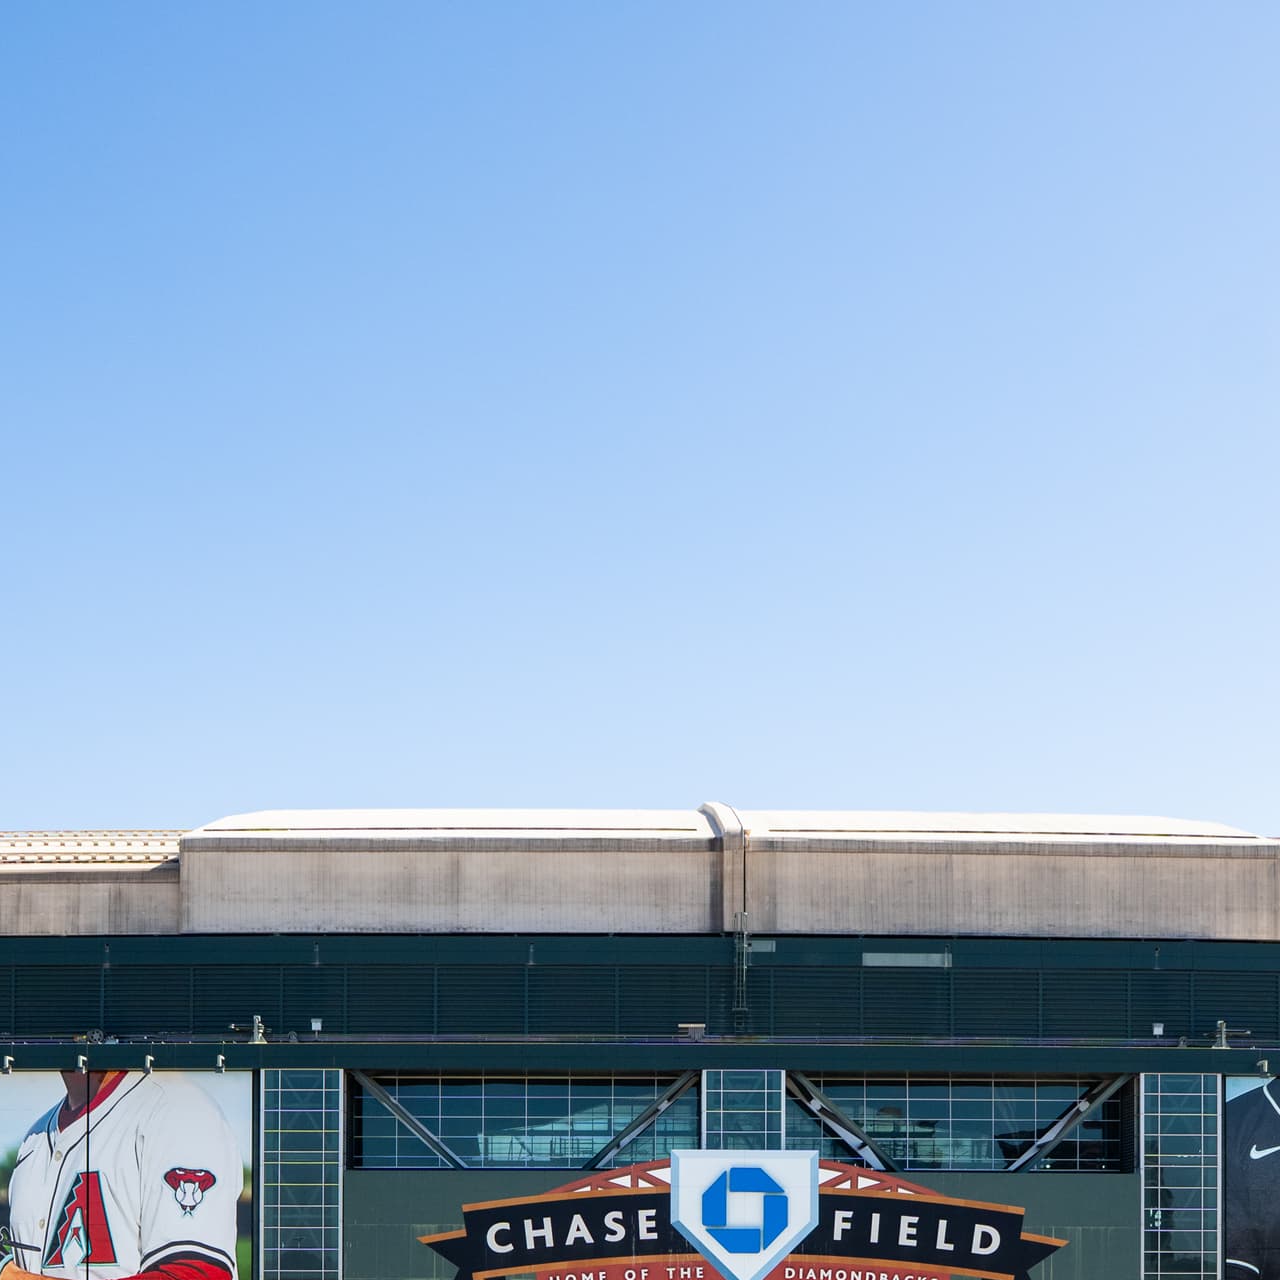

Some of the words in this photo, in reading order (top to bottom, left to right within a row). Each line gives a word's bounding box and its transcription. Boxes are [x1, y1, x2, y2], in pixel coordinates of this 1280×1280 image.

[485, 1209, 659, 1255] CHASE
[832, 1210, 1002, 1255] FIELD
[666, 1265, 705, 1280] THE
